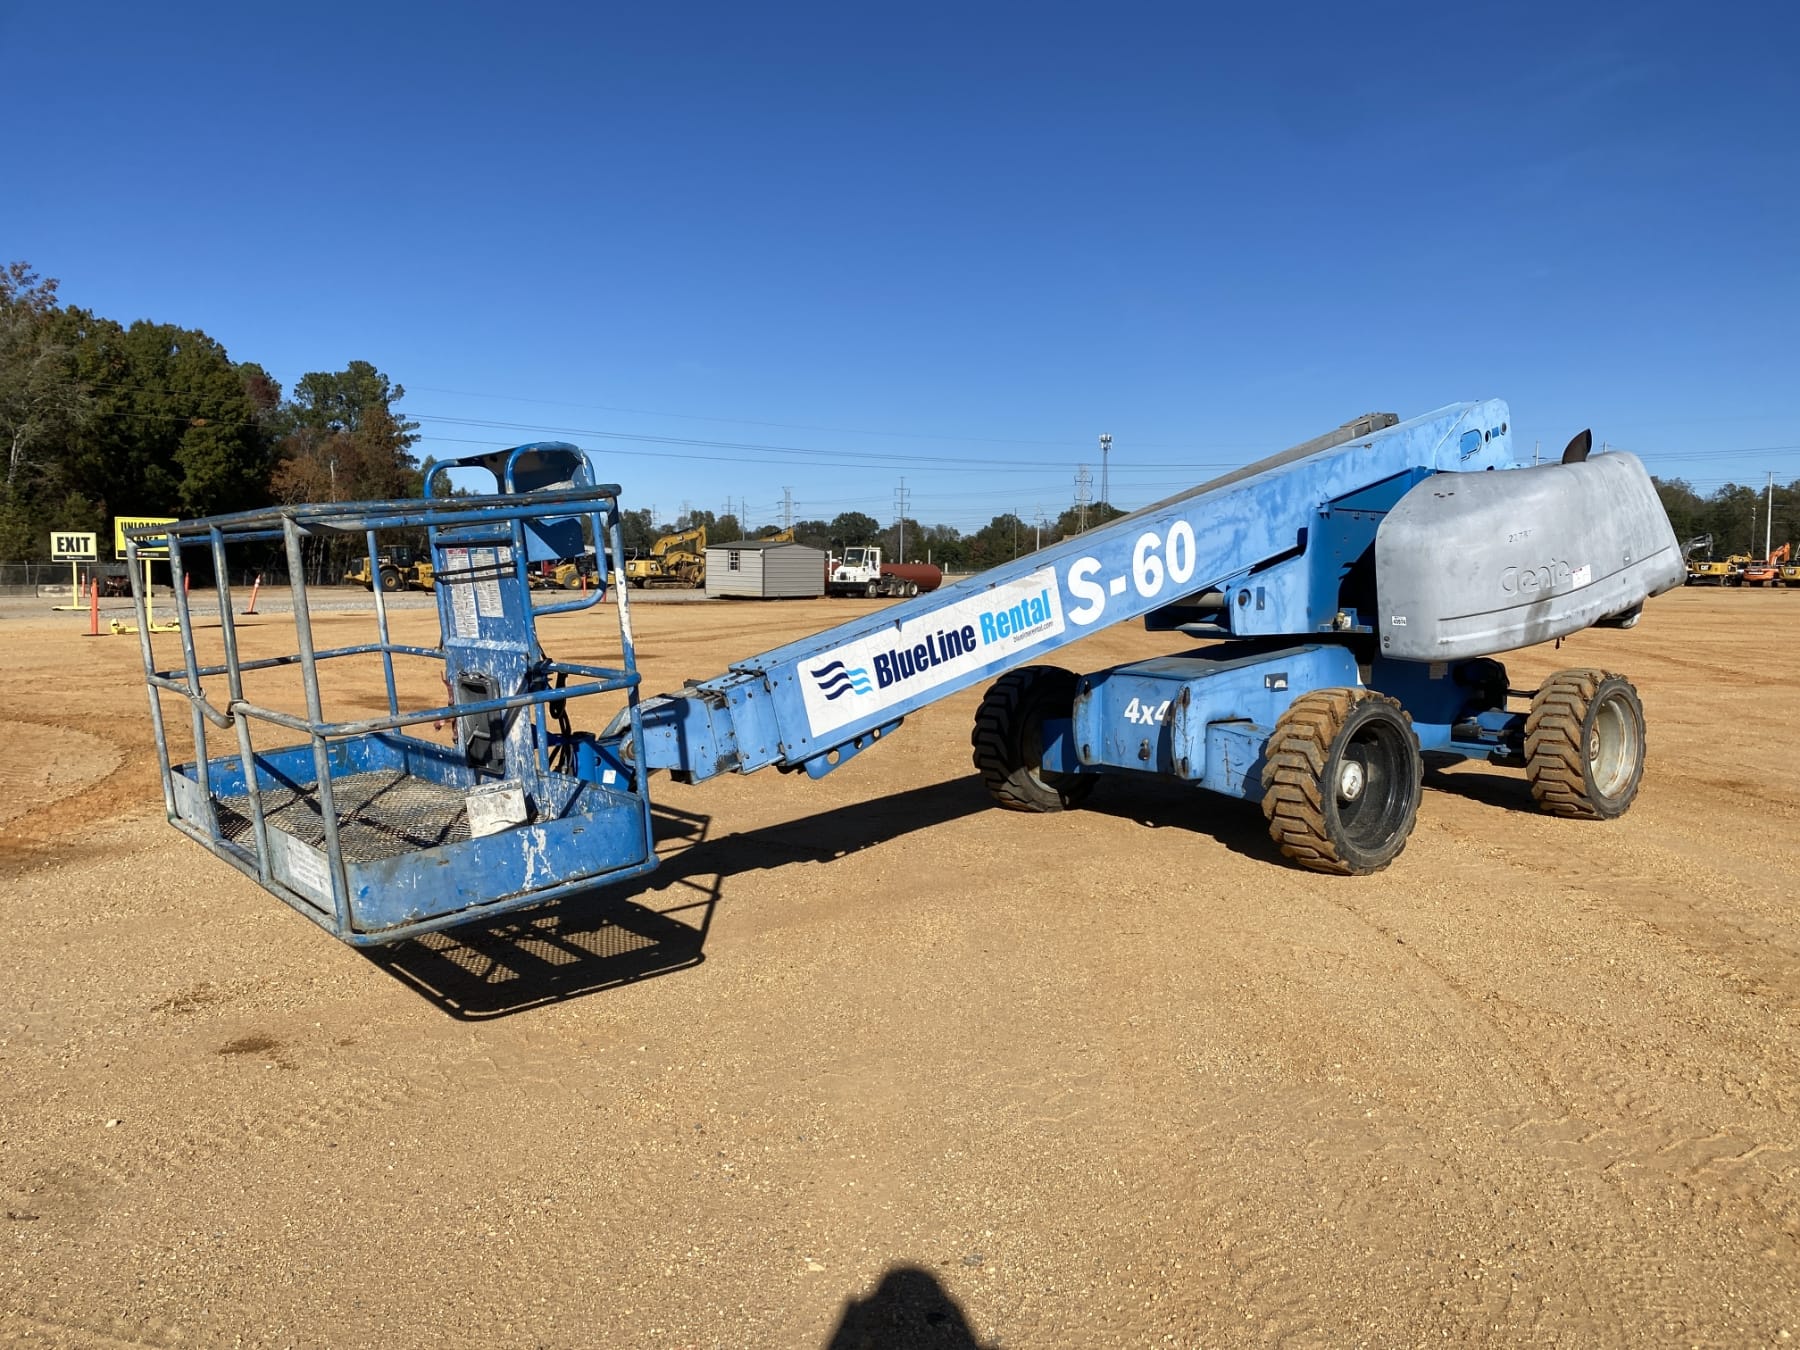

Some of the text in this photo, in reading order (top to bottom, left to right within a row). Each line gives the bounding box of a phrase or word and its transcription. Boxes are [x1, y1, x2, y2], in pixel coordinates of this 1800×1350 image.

[56, 536, 91, 553] EXIT
[1068, 520, 1196, 626] S-60
[873, 589, 1052, 689] BlueLine Rental
